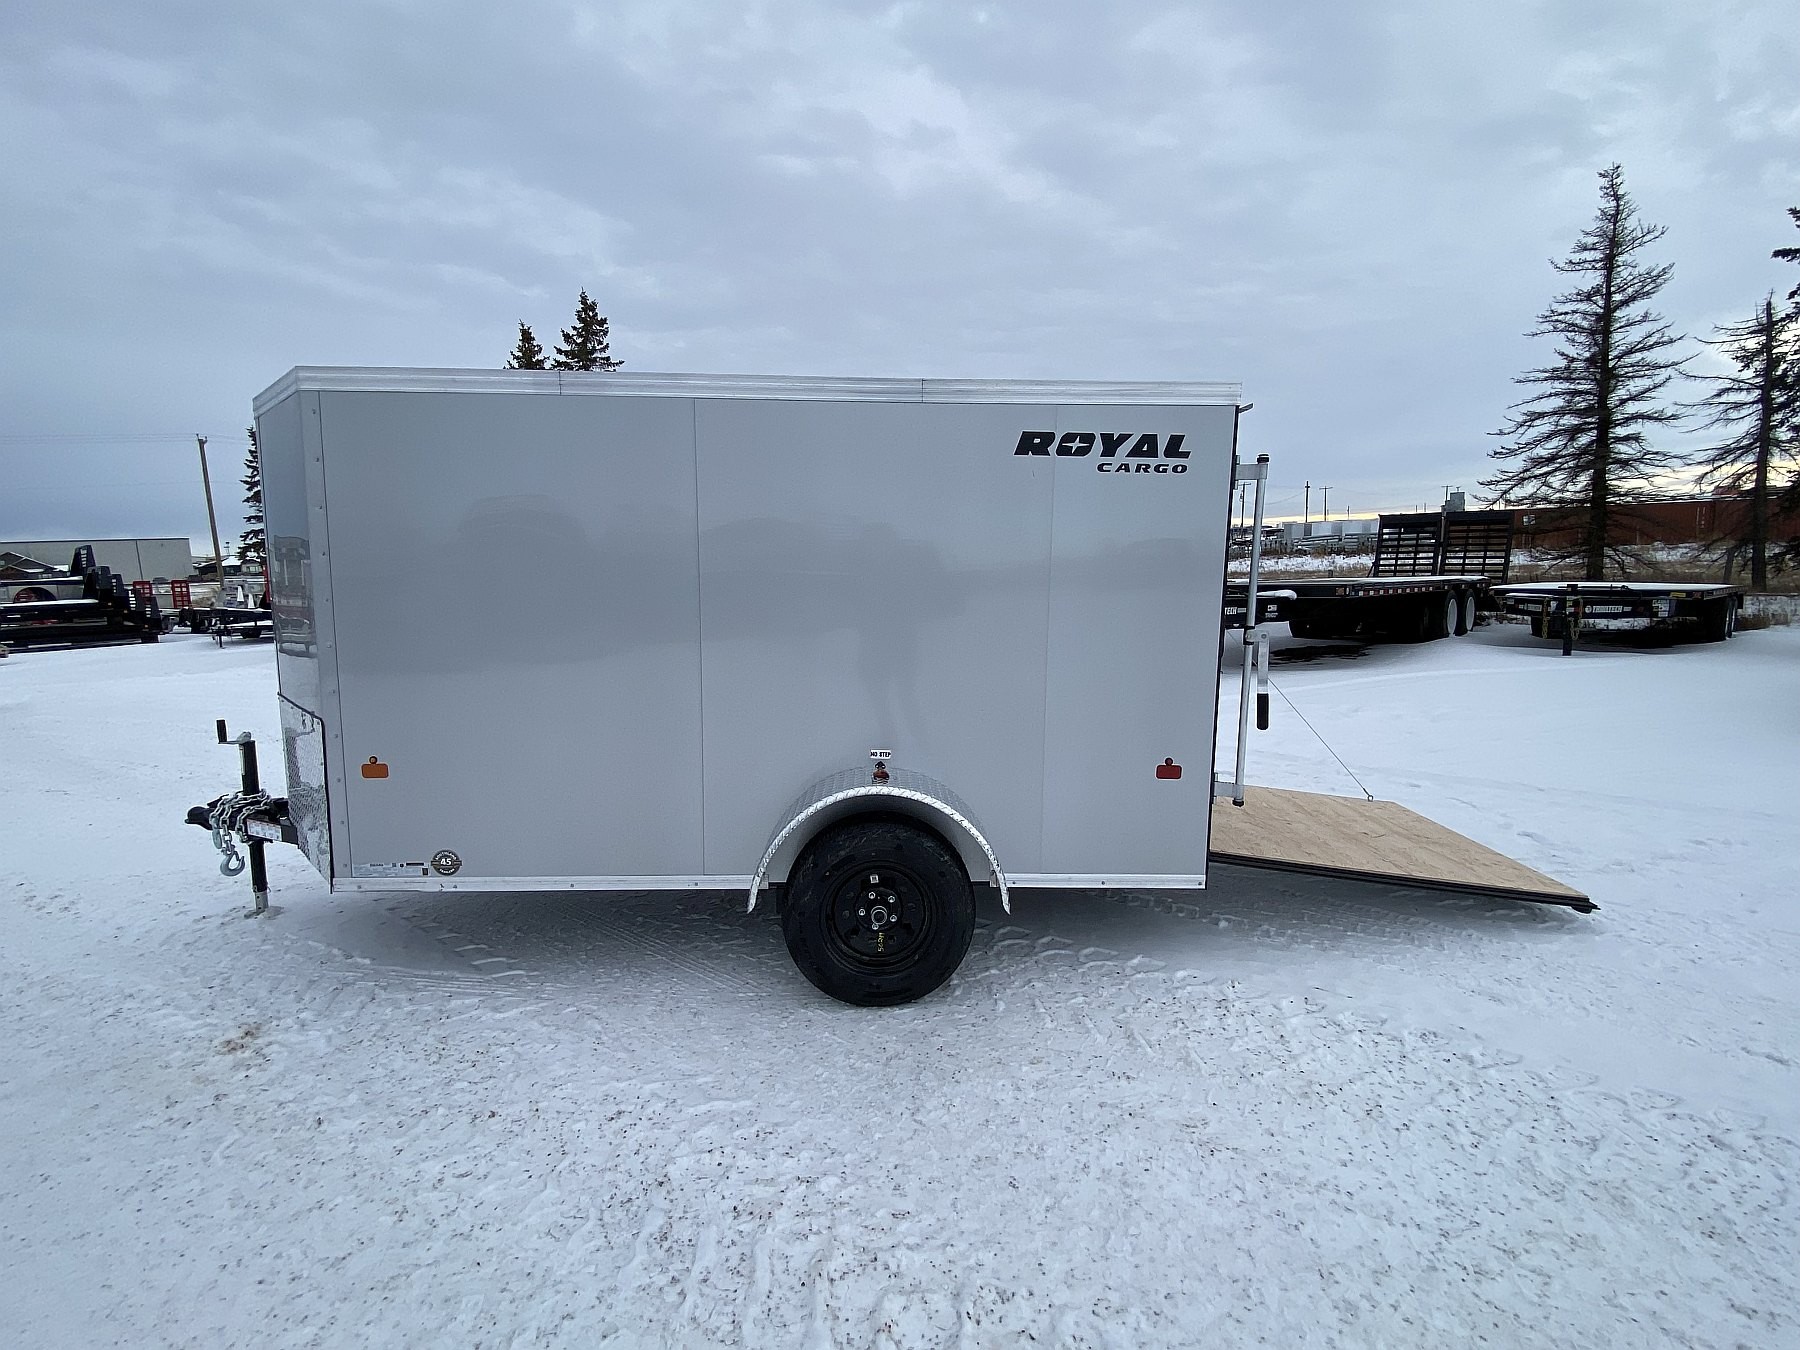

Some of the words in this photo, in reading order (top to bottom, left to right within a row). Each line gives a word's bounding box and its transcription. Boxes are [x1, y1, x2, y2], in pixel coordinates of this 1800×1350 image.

[1014, 431, 1191, 459] ROYAL
[1097, 463, 1188, 473] CARGO
[440, 858, 452, 866] 45
